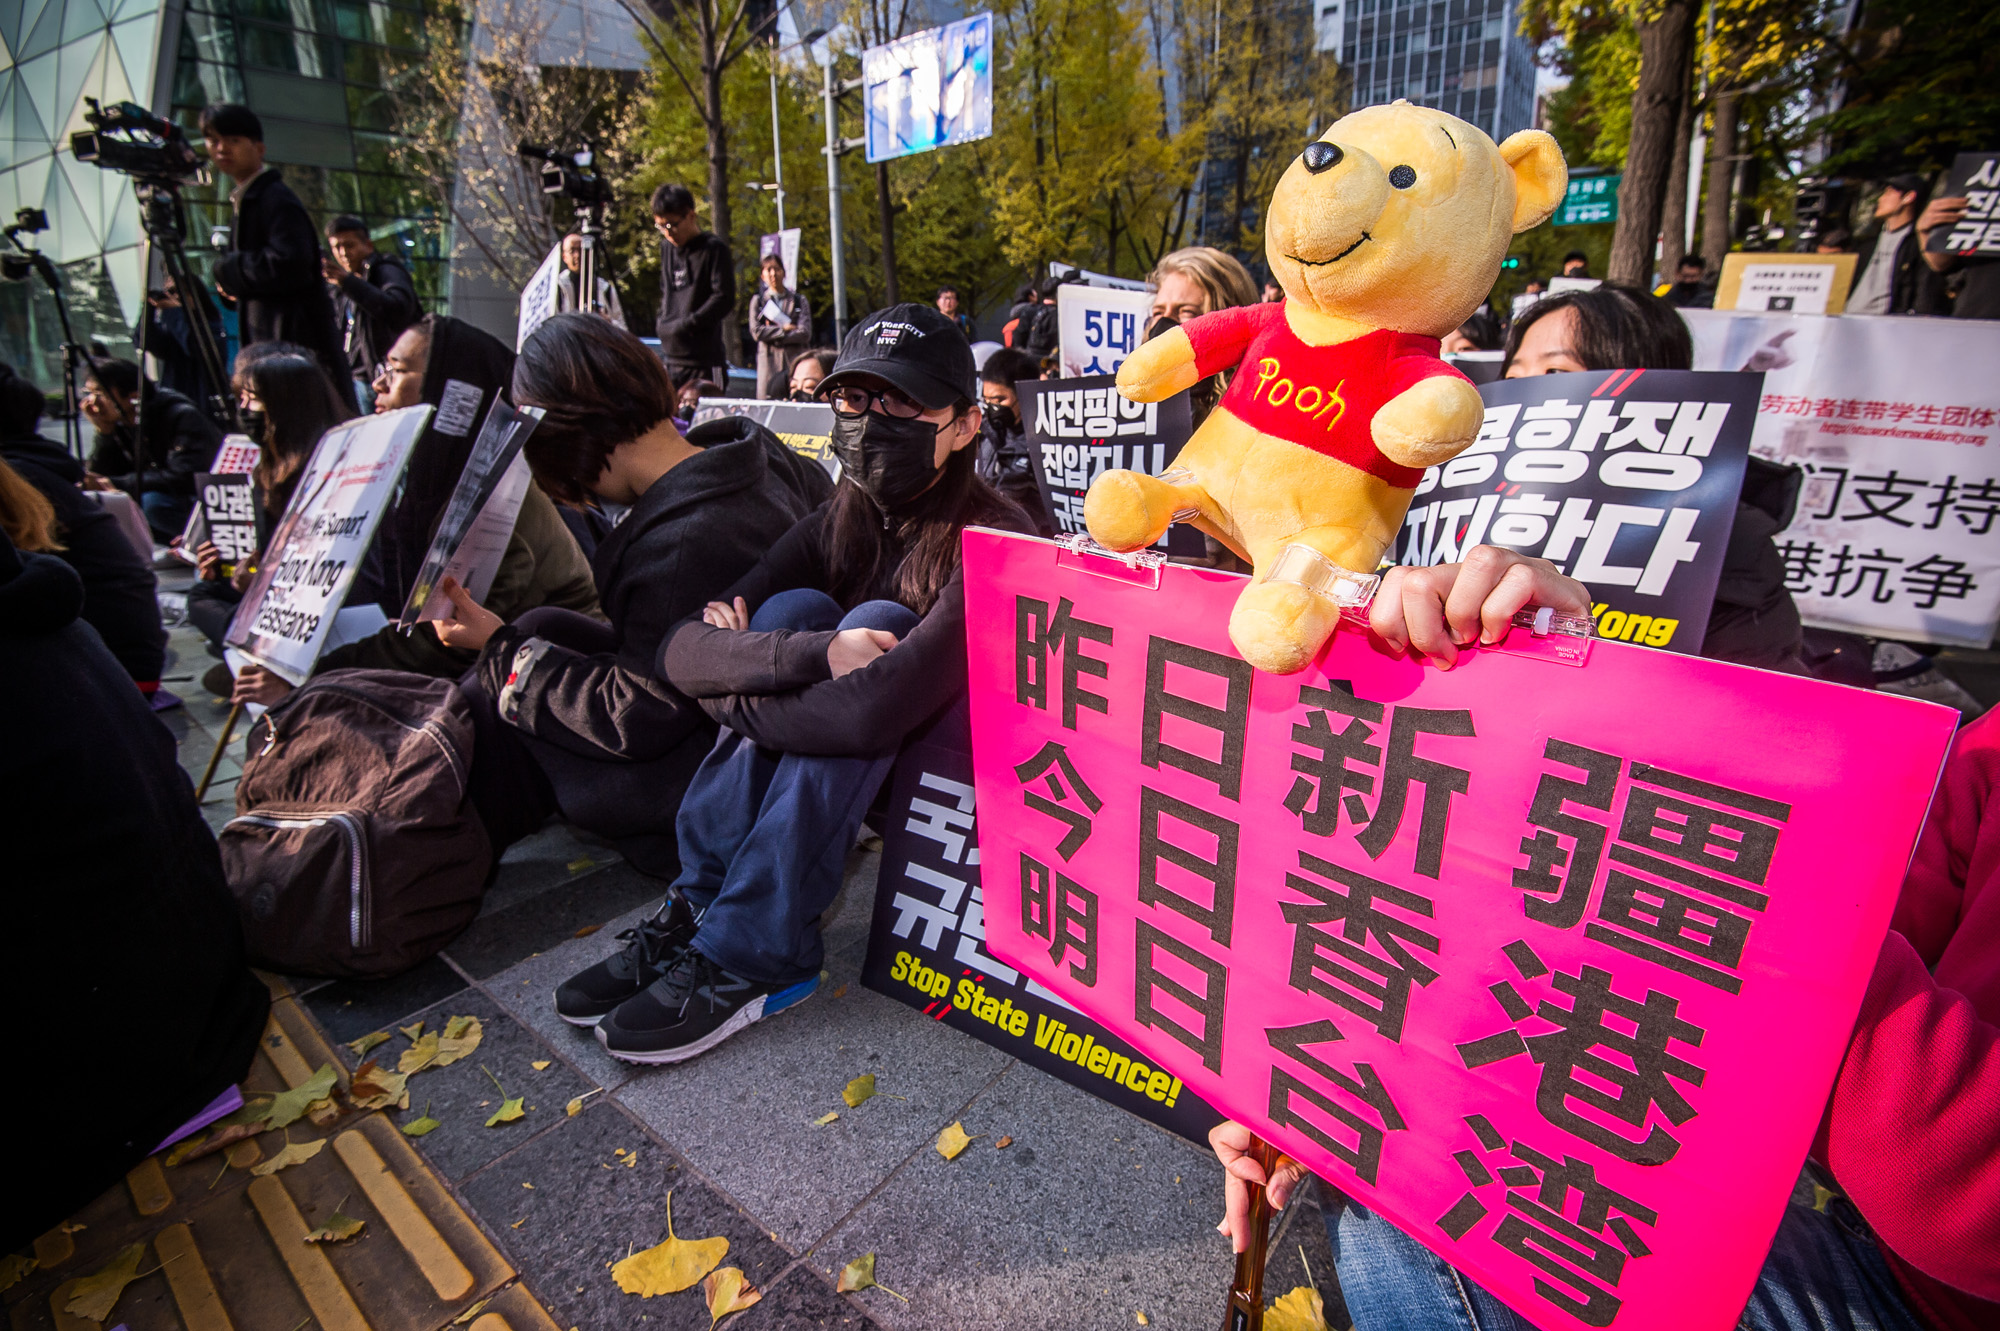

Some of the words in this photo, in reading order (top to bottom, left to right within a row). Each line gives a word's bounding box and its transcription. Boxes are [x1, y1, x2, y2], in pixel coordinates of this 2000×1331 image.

[876, 337, 897, 345] NYC
[881, 321, 905, 330] YORK
[904, 323, 926, 338] CITY
[1085, 309, 1135, 354] 5대
[1034, 386, 1158, 438] 시진핑의
[1253, 357, 1346, 431] Pooh
[1758, 394, 2000, 429] 劳动者连带学生团体
[890, 950, 952, 999] Stop
[952, 978, 1029, 1038] State
[1033, 1012, 1183, 1108] Violence!
